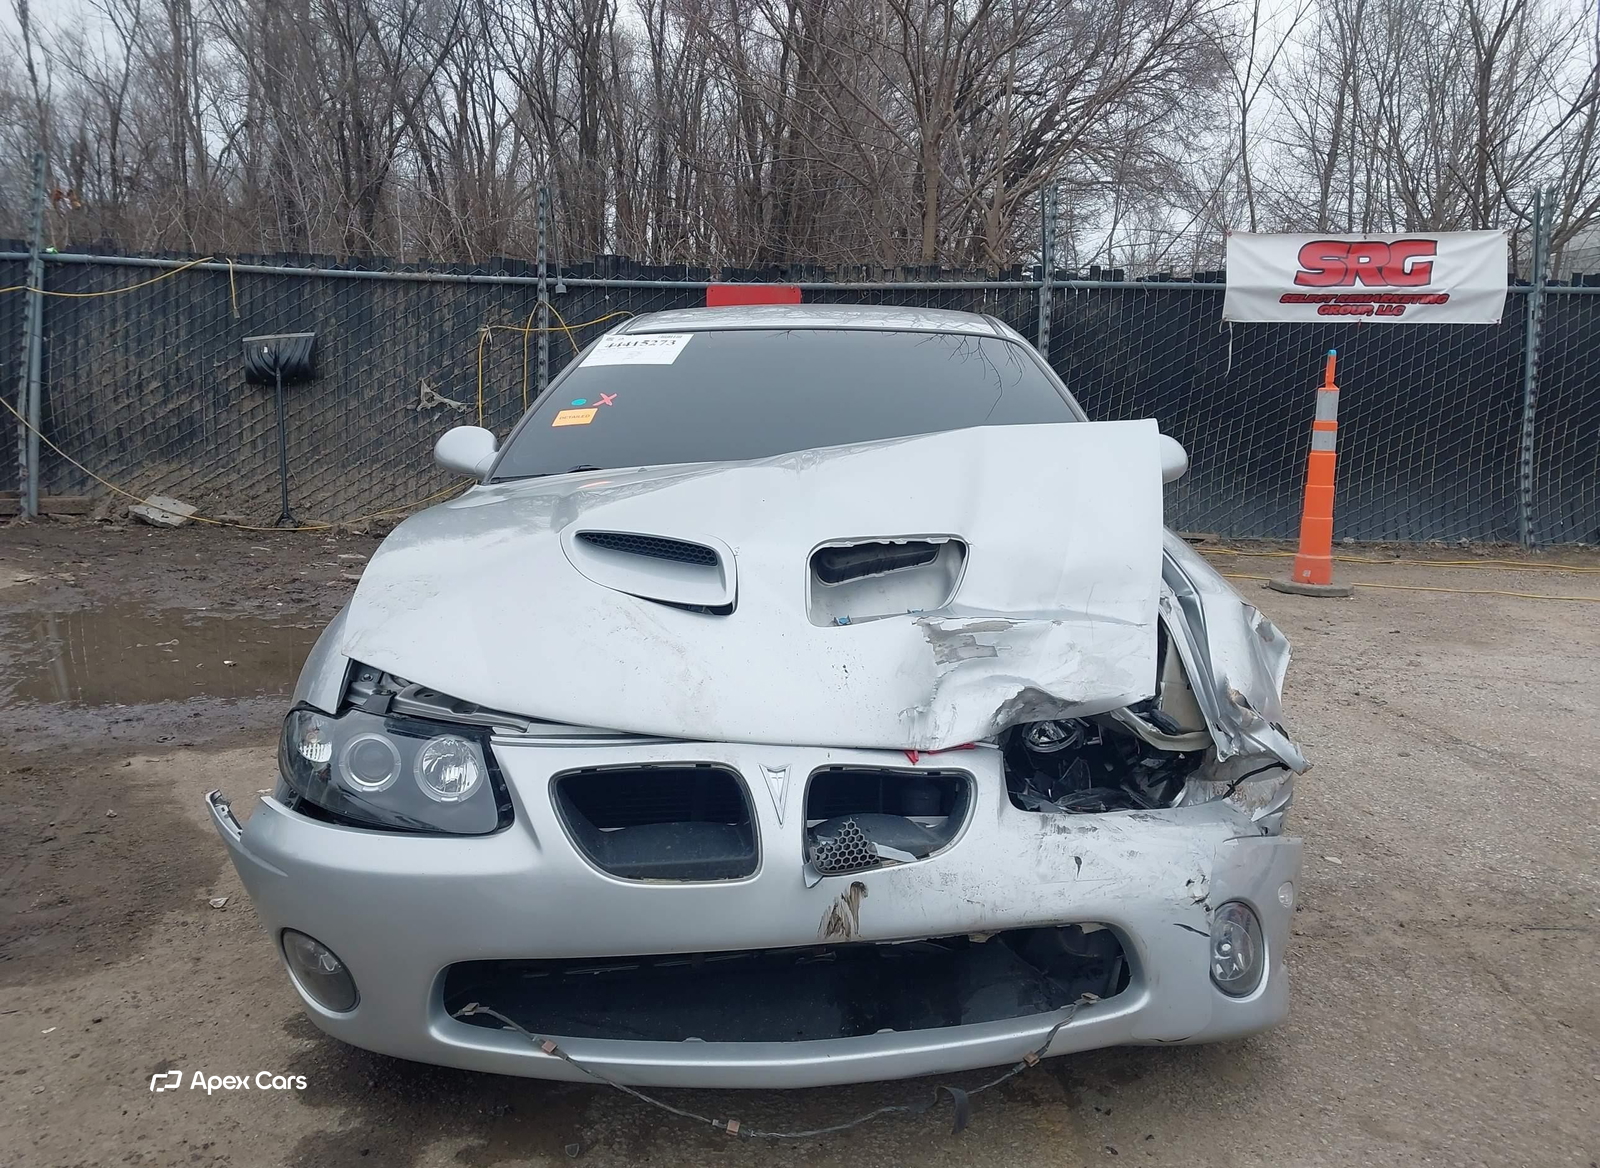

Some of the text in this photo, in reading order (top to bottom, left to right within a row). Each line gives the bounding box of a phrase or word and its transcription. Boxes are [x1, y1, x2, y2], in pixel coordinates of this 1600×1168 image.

[1294, 239, 1438, 287] SRG
[1279, 293, 1450, 304] SELECT REMARKETING
[1317, 304, 1406, 317] GROUP, LLC
